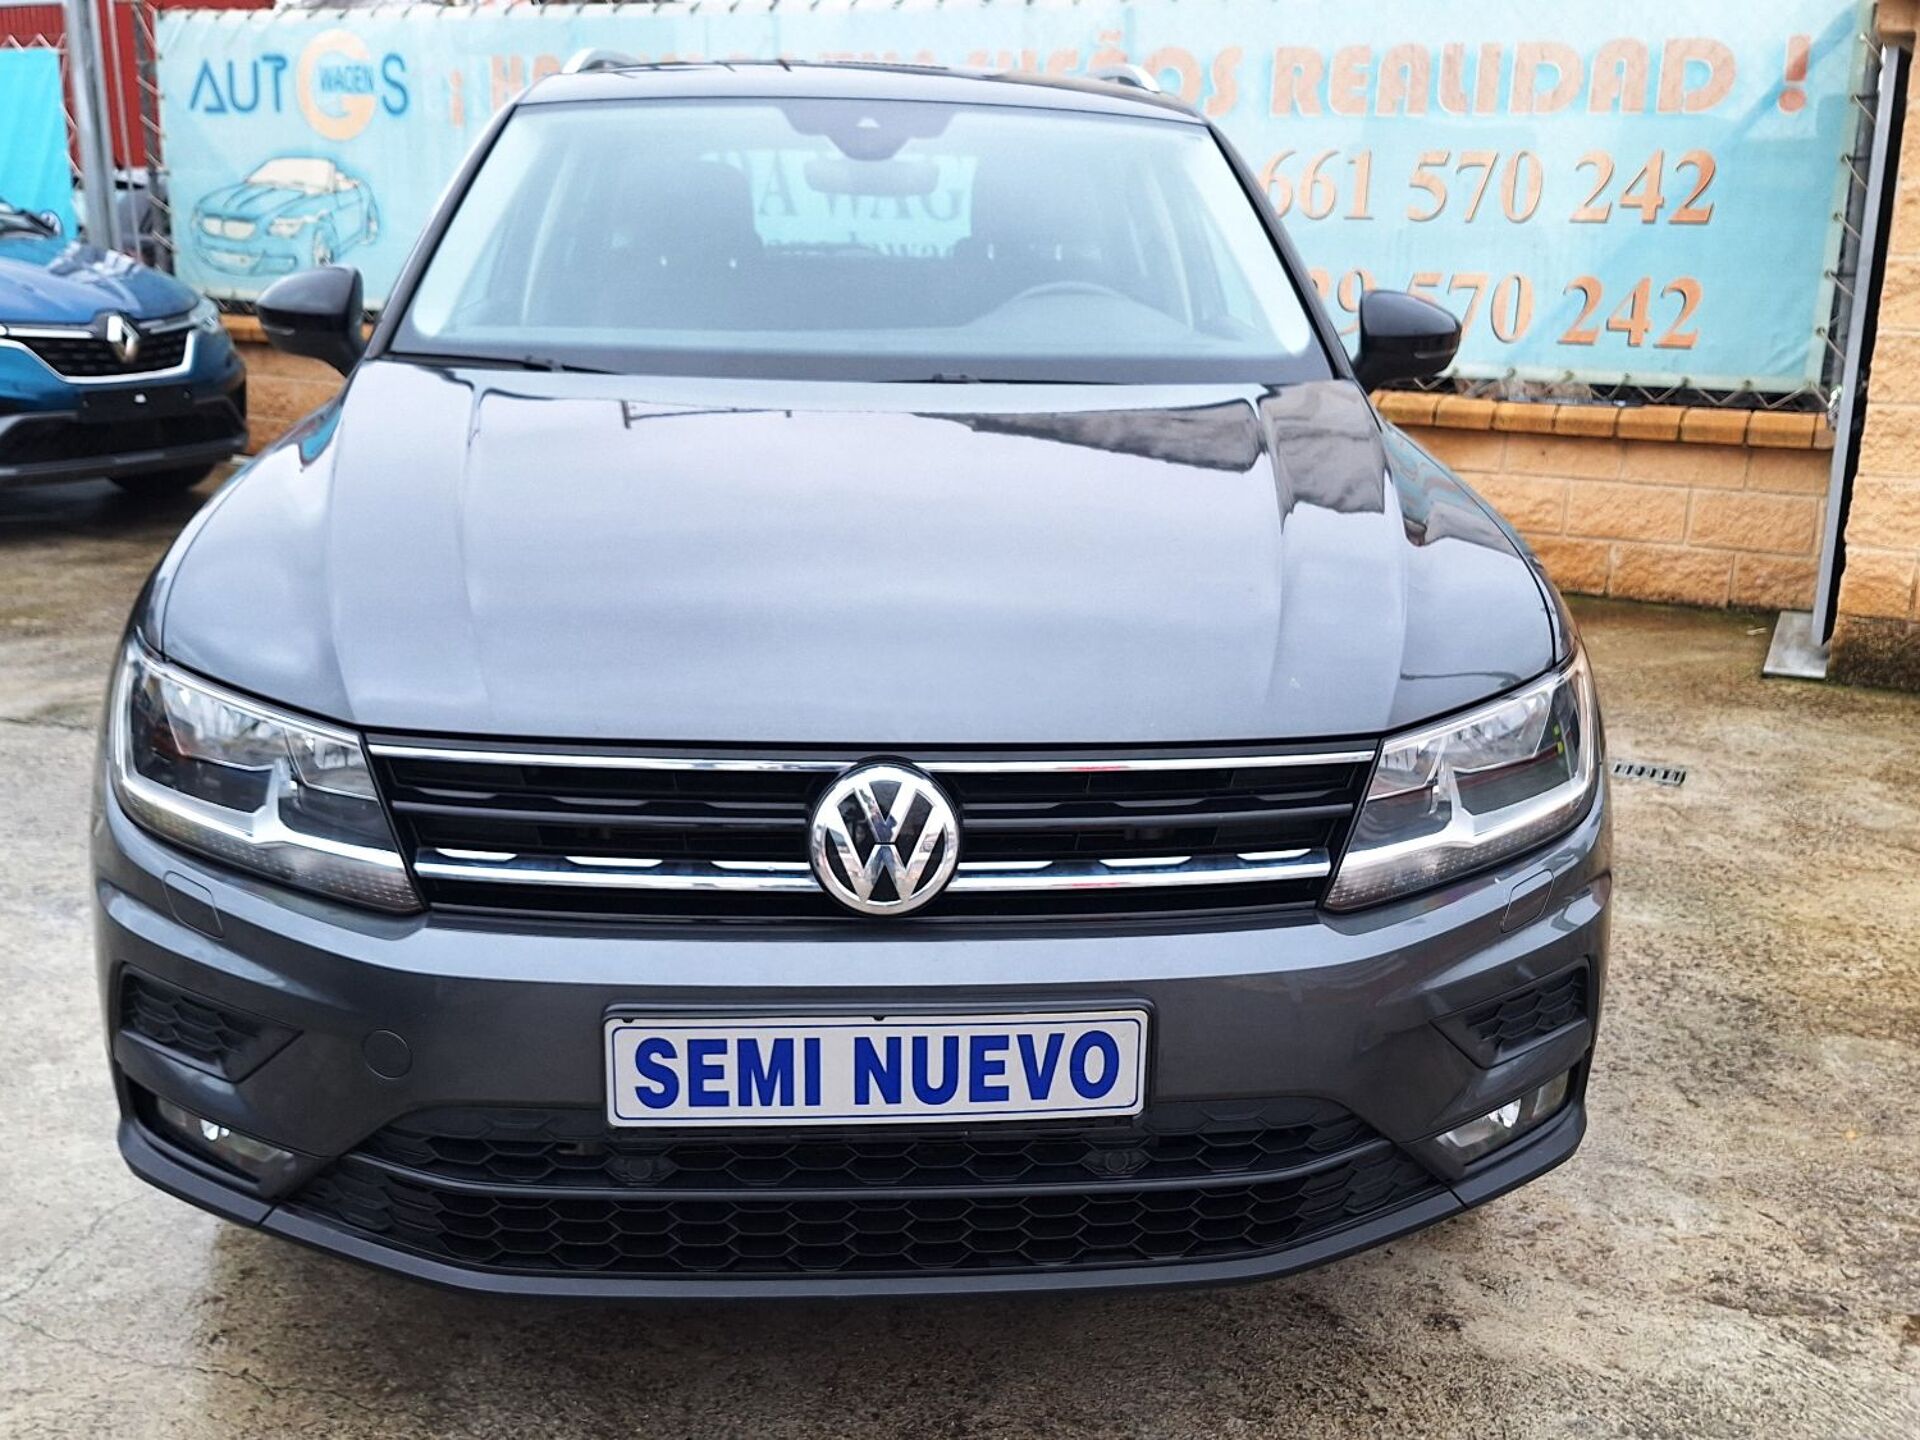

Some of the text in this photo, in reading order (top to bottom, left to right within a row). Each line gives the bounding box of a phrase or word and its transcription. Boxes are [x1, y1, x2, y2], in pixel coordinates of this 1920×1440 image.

[1270, 37, 1737, 117] REALIDAD
[1777, 34, 1811, 114] !
[1259, 149, 1716, 225] 661 570 242
[1557, 274, 1704, 349] 242
[634, 1030, 1120, 1108] SEMI NUEVO
